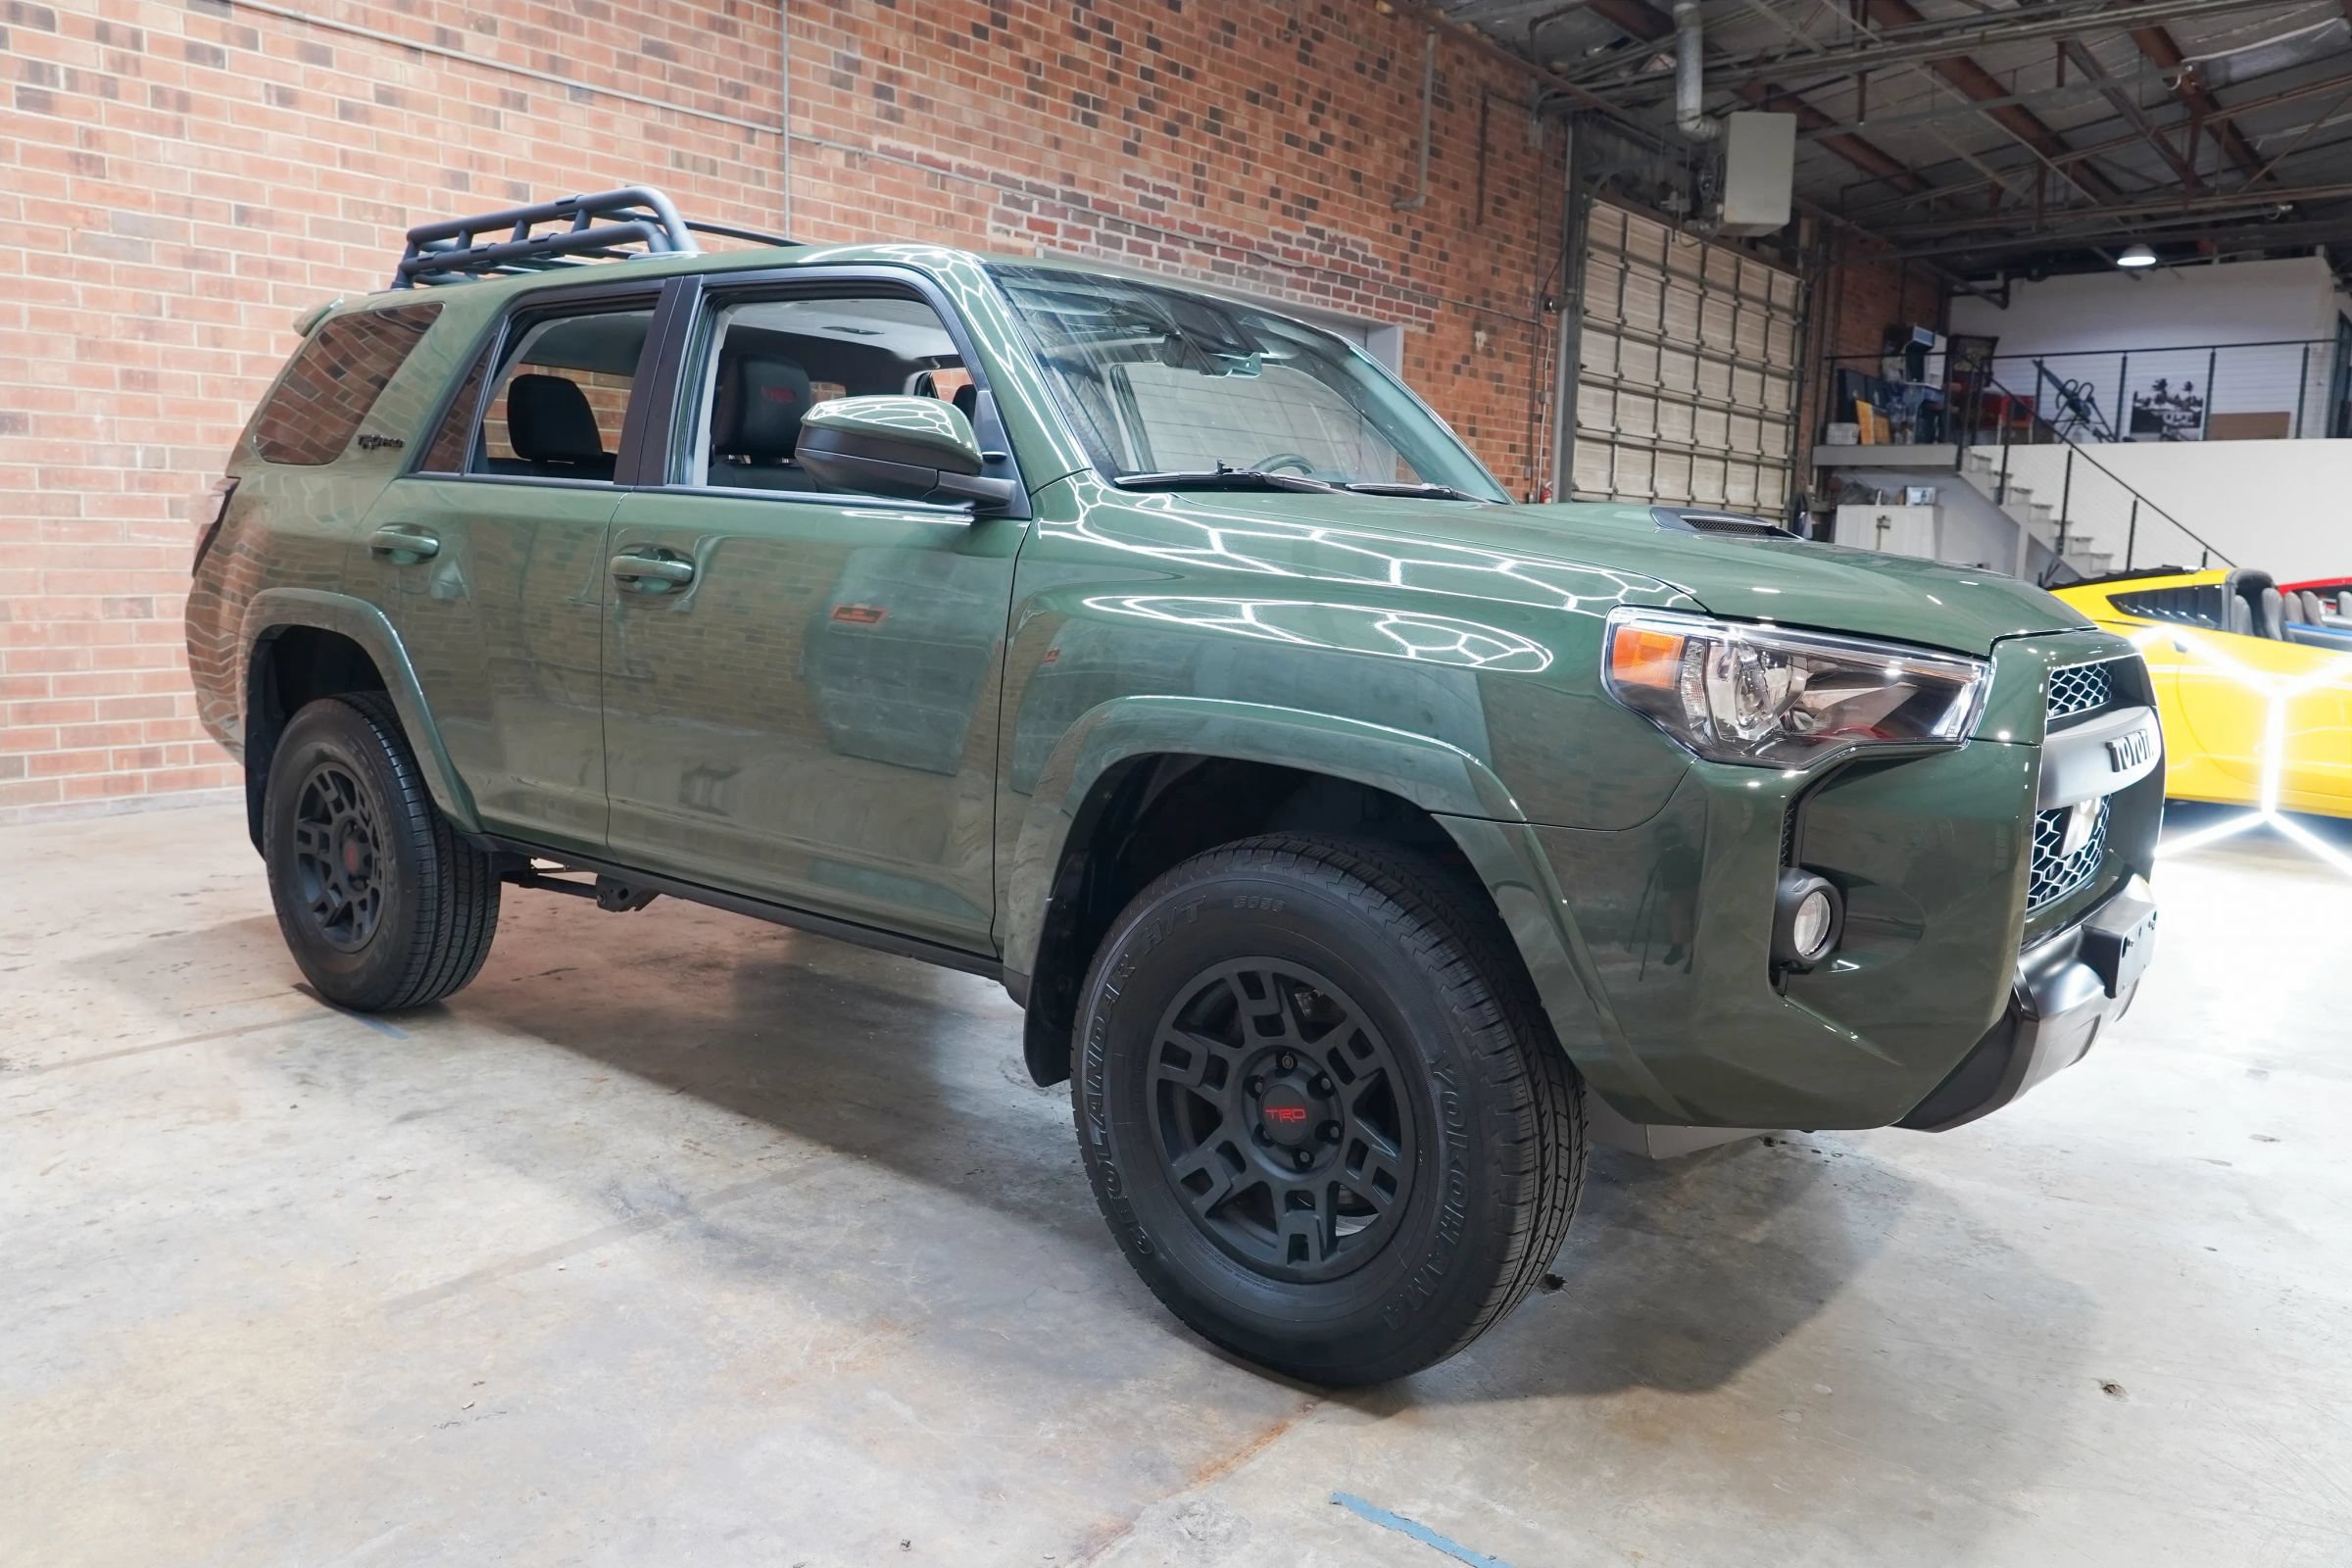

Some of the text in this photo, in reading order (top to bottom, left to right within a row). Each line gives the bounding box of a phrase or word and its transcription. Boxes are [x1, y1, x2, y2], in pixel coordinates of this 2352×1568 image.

[1143, 894, 1206, 956] H/T
[1264, 1107, 1306, 1123] TRD
[1380, 1050, 1472, 1331] YOKOHAMA
